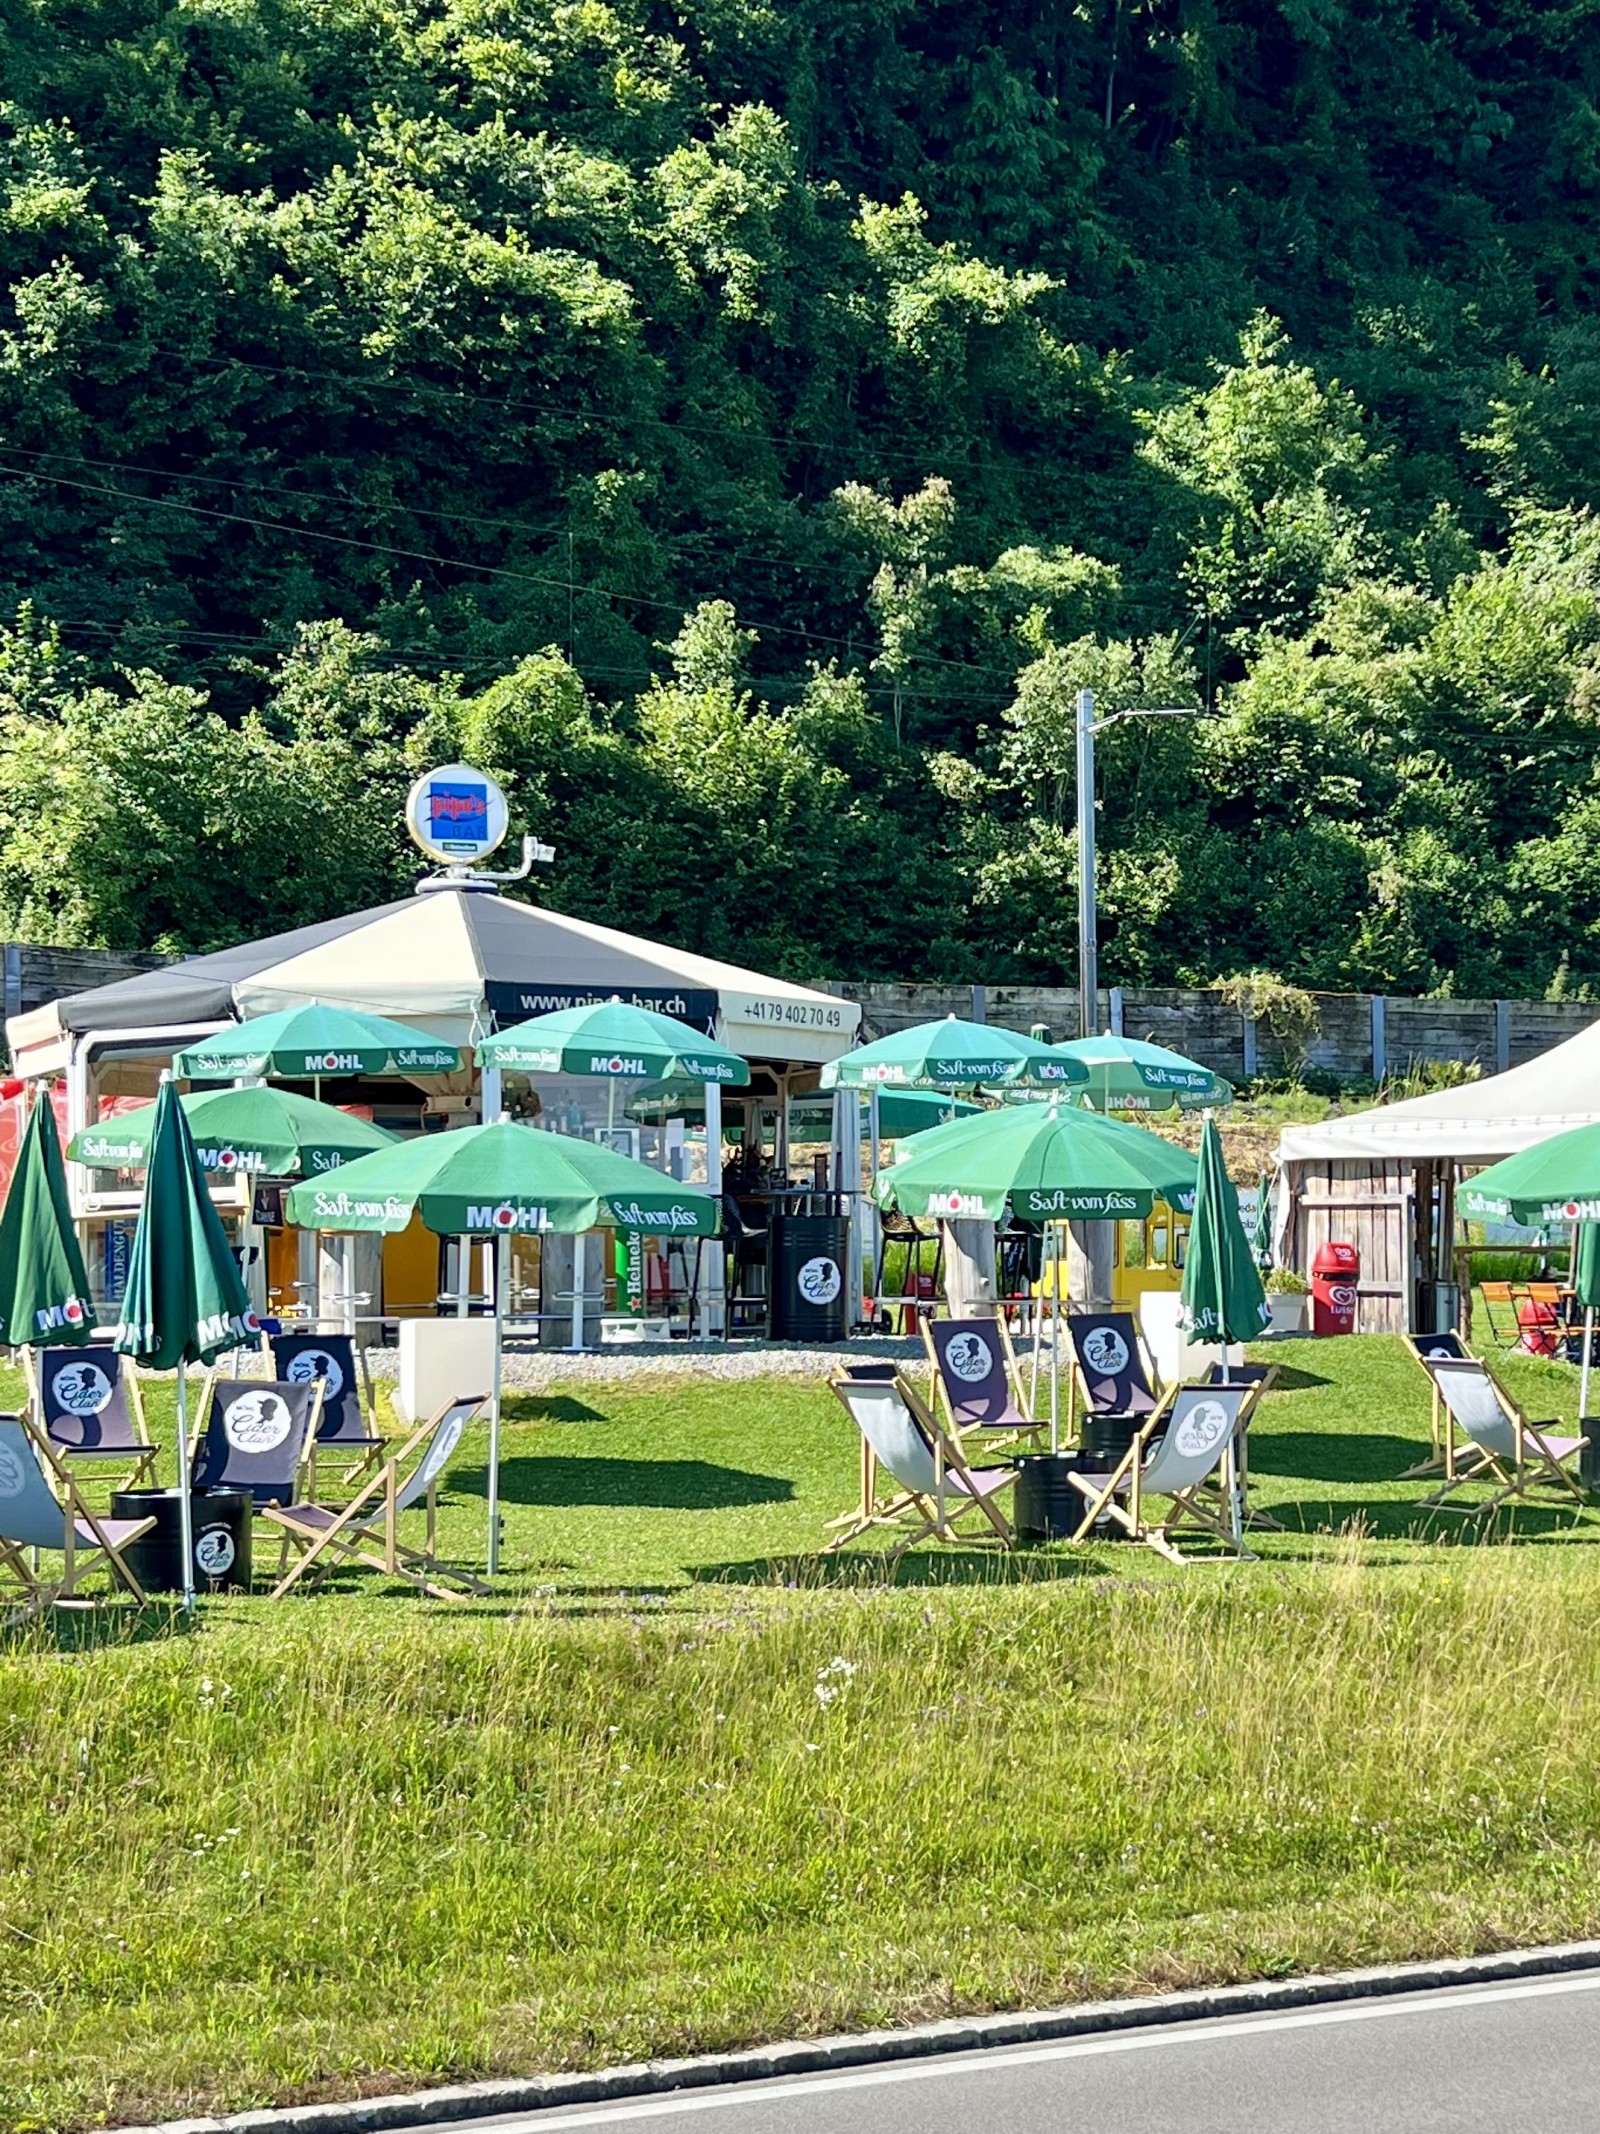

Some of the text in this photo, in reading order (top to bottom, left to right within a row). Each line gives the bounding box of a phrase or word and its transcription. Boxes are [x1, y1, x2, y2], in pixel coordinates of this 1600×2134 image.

[520, 992, 687, 1015] www.pi-bar.ch
[768, 1003, 783, 1021] 79
[785, 1005, 807, 1024] 402
[809, 1008, 824, 1026] 70
[826, 1010, 841, 1027] 49
[313, 1192, 354, 1217] Saft
[1028, 1190, 1070, 1212] Saft
[1070, 1196, 1105, 1211] vom
[627, 1231, 641, 1295] Heinek
